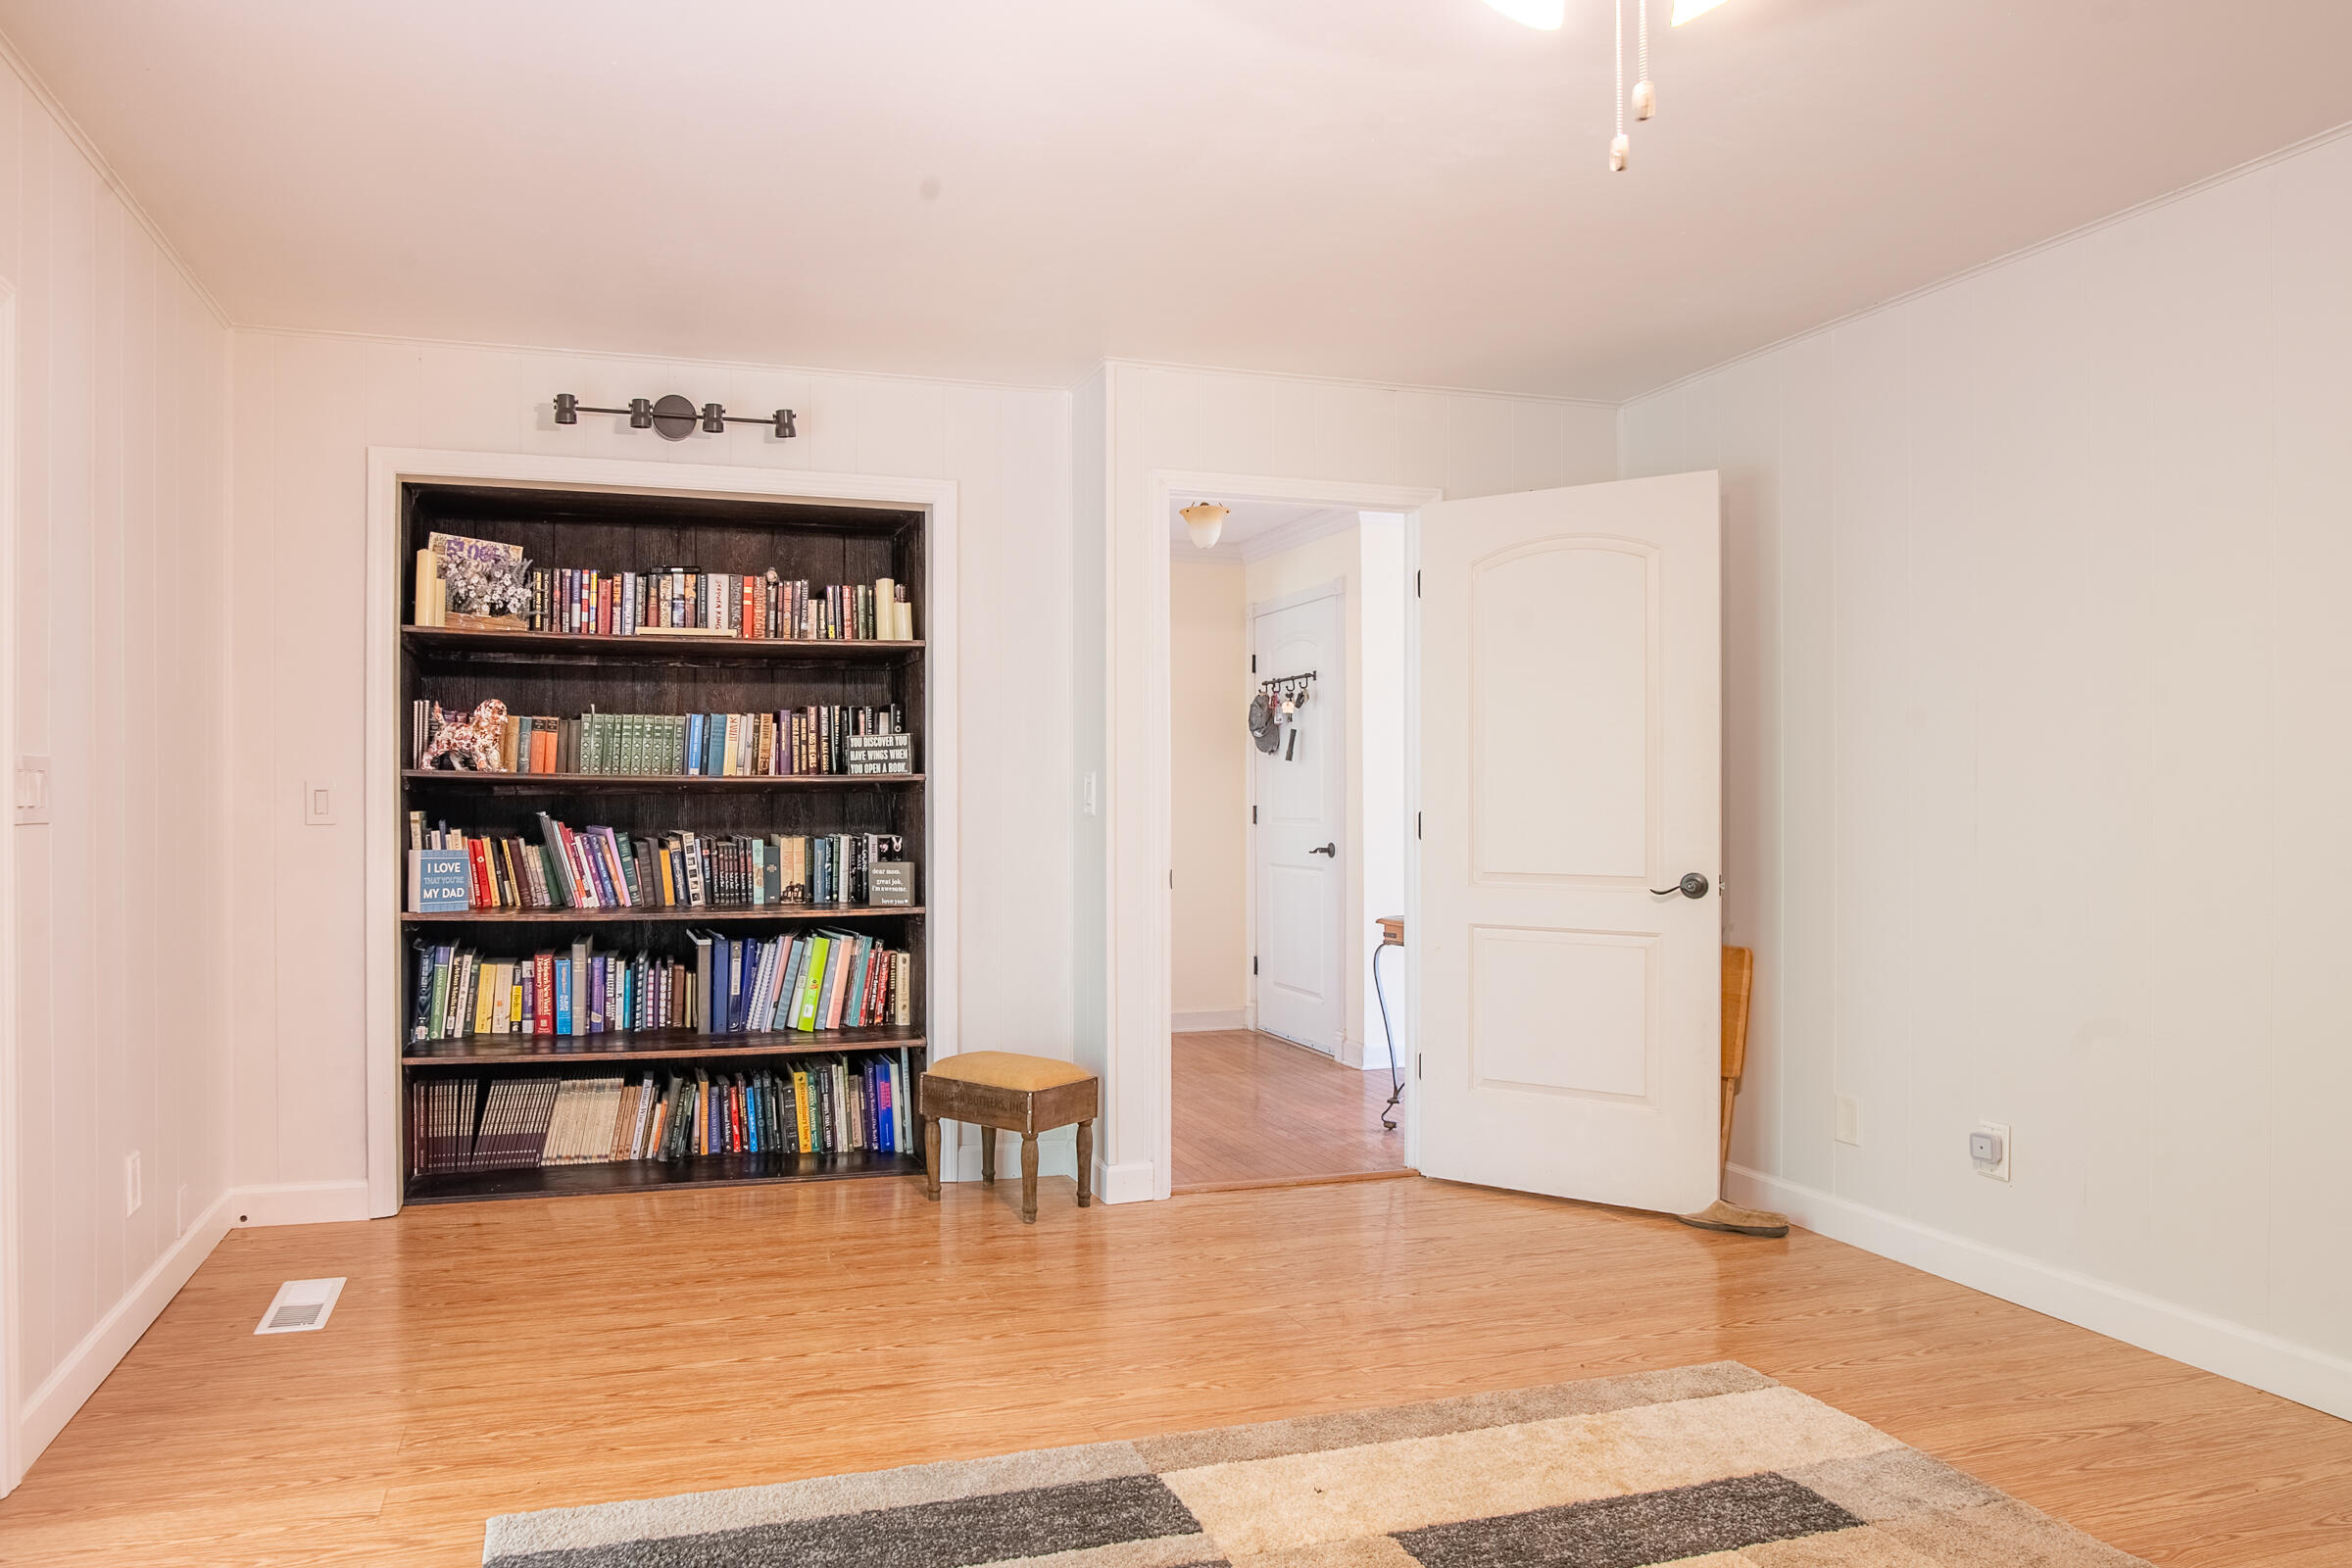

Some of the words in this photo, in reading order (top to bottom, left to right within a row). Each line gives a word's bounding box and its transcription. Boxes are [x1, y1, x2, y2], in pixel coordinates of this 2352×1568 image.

[850, 737, 862, 748] YOU
[863, 736, 894, 747] DISCOVER
[895, 735, 907, 746] YOU
[850, 750, 866, 761] HAVE
[867, 749, 888, 760] WINGS
[889, 749, 907, 760] WHEN
[851, 763, 862, 774] YOU
[864, 763, 881, 774] OPEN
[882, 762, 887, 773] A
[889, 761, 907, 773] BOOK.
[427, 862, 431, 873] I
[434, 862, 461, 873] LOVE
[423, 888, 439, 899] MY
[442, 887, 465, 899] DAD
[450, 987, 459, 1016] Medicine
[967, 1096, 1006, 1111] BOTTLERS,
[1009, 1101, 1026, 1114] INC.
